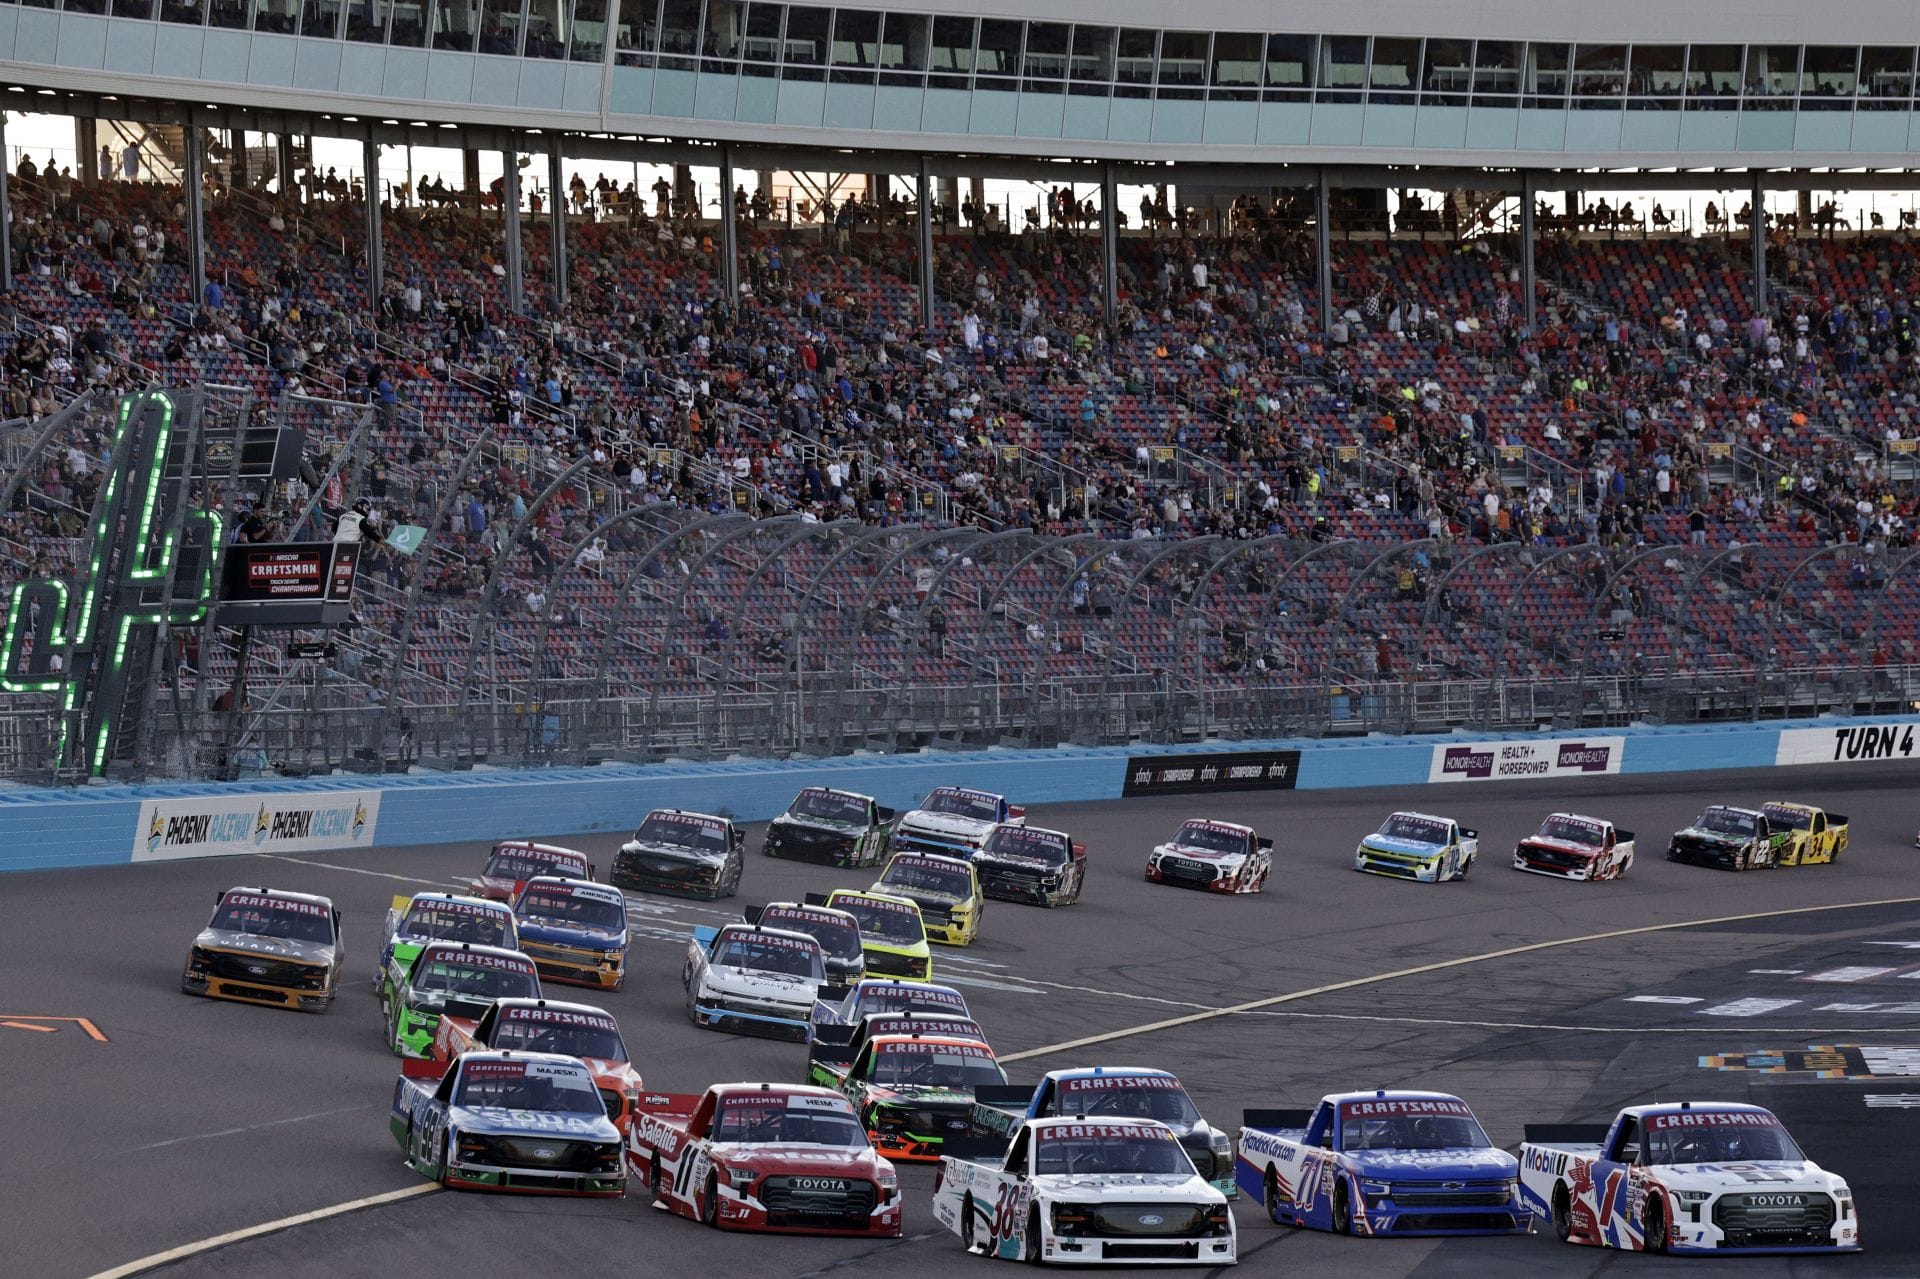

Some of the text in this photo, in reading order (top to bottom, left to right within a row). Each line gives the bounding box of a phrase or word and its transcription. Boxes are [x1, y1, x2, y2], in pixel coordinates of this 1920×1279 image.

[252, 564, 317, 575] CRAFTSMAN
[1834, 725, 1914, 760] TURN 4
[1501, 746, 1530, 758] HEALTH
[1560, 750, 1608, 764] HONORHEALTH
[1446, 755, 1493, 769] HONORHEALTH
[1498, 760, 1550, 775] HORSEPOWER
[936, 789, 994, 804] CRAFTSMAN
[165, 809, 351, 845] PHOENIX RACEWAY PHOENIX RACEWAY
[653, 814, 719, 830] CRAFTSMAN
[1000, 828, 1060, 843] CRAFTSMAN
[1809, 835, 1824, 858] 34
[501, 847, 582, 868] CRAFTSMAN
[899, 857, 966, 873] CRAFTSMAN
[1178, 859, 1202, 868] TOYOTA
[230, 895, 319, 914] CRAFTSMAN
[419, 900, 505, 920] CRAFTSMAN
[838, 895, 913, 915] CRAFTSMAN
[770, 908, 849, 927] CRAFTSMAN
[730, 931, 814, 952] CRAFTSMAN
[435, 951, 529, 974] CRAFTSMAN
[868, 986, 958, 1004] CRAFTSMAN
[509, 1009, 609, 1029] CRAFTSMAN
[880, 1022, 973, 1034] CRAFTSMAN
[886, 1043, 985, 1058] CRAFTSMAN
[536, 1067, 579, 1077] MAJESKI
[1070, 1077, 1172, 1090] CRAFTSMAN
[726, 1096, 833, 1107] CRAFTSMAN HEIM
[1351, 1101, 1460, 1116] CRAFTSMAN
[485, 1112, 597, 1131] SODA
[1656, 1113, 1772, 1128] CRAFTSMAN
[639, 1115, 678, 1153] Safelite
[1042, 1125, 1170, 1141] CRAFTSMAN
[1525, 1146, 1556, 1175] Mobil
[1557, 1153, 1569, 1176] 1
[673, 1143, 700, 1197] 11
[794, 1178, 846, 1190] TOYOTA
[1600, 1168, 1626, 1230] 1
[1750, 1195, 1803, 1206] TOYOTA
[989, 1182, 1020, 1240] 38
[1374, 1215, 1393, 1230] 71
[1695, 1231, 1704, 1242] 1
